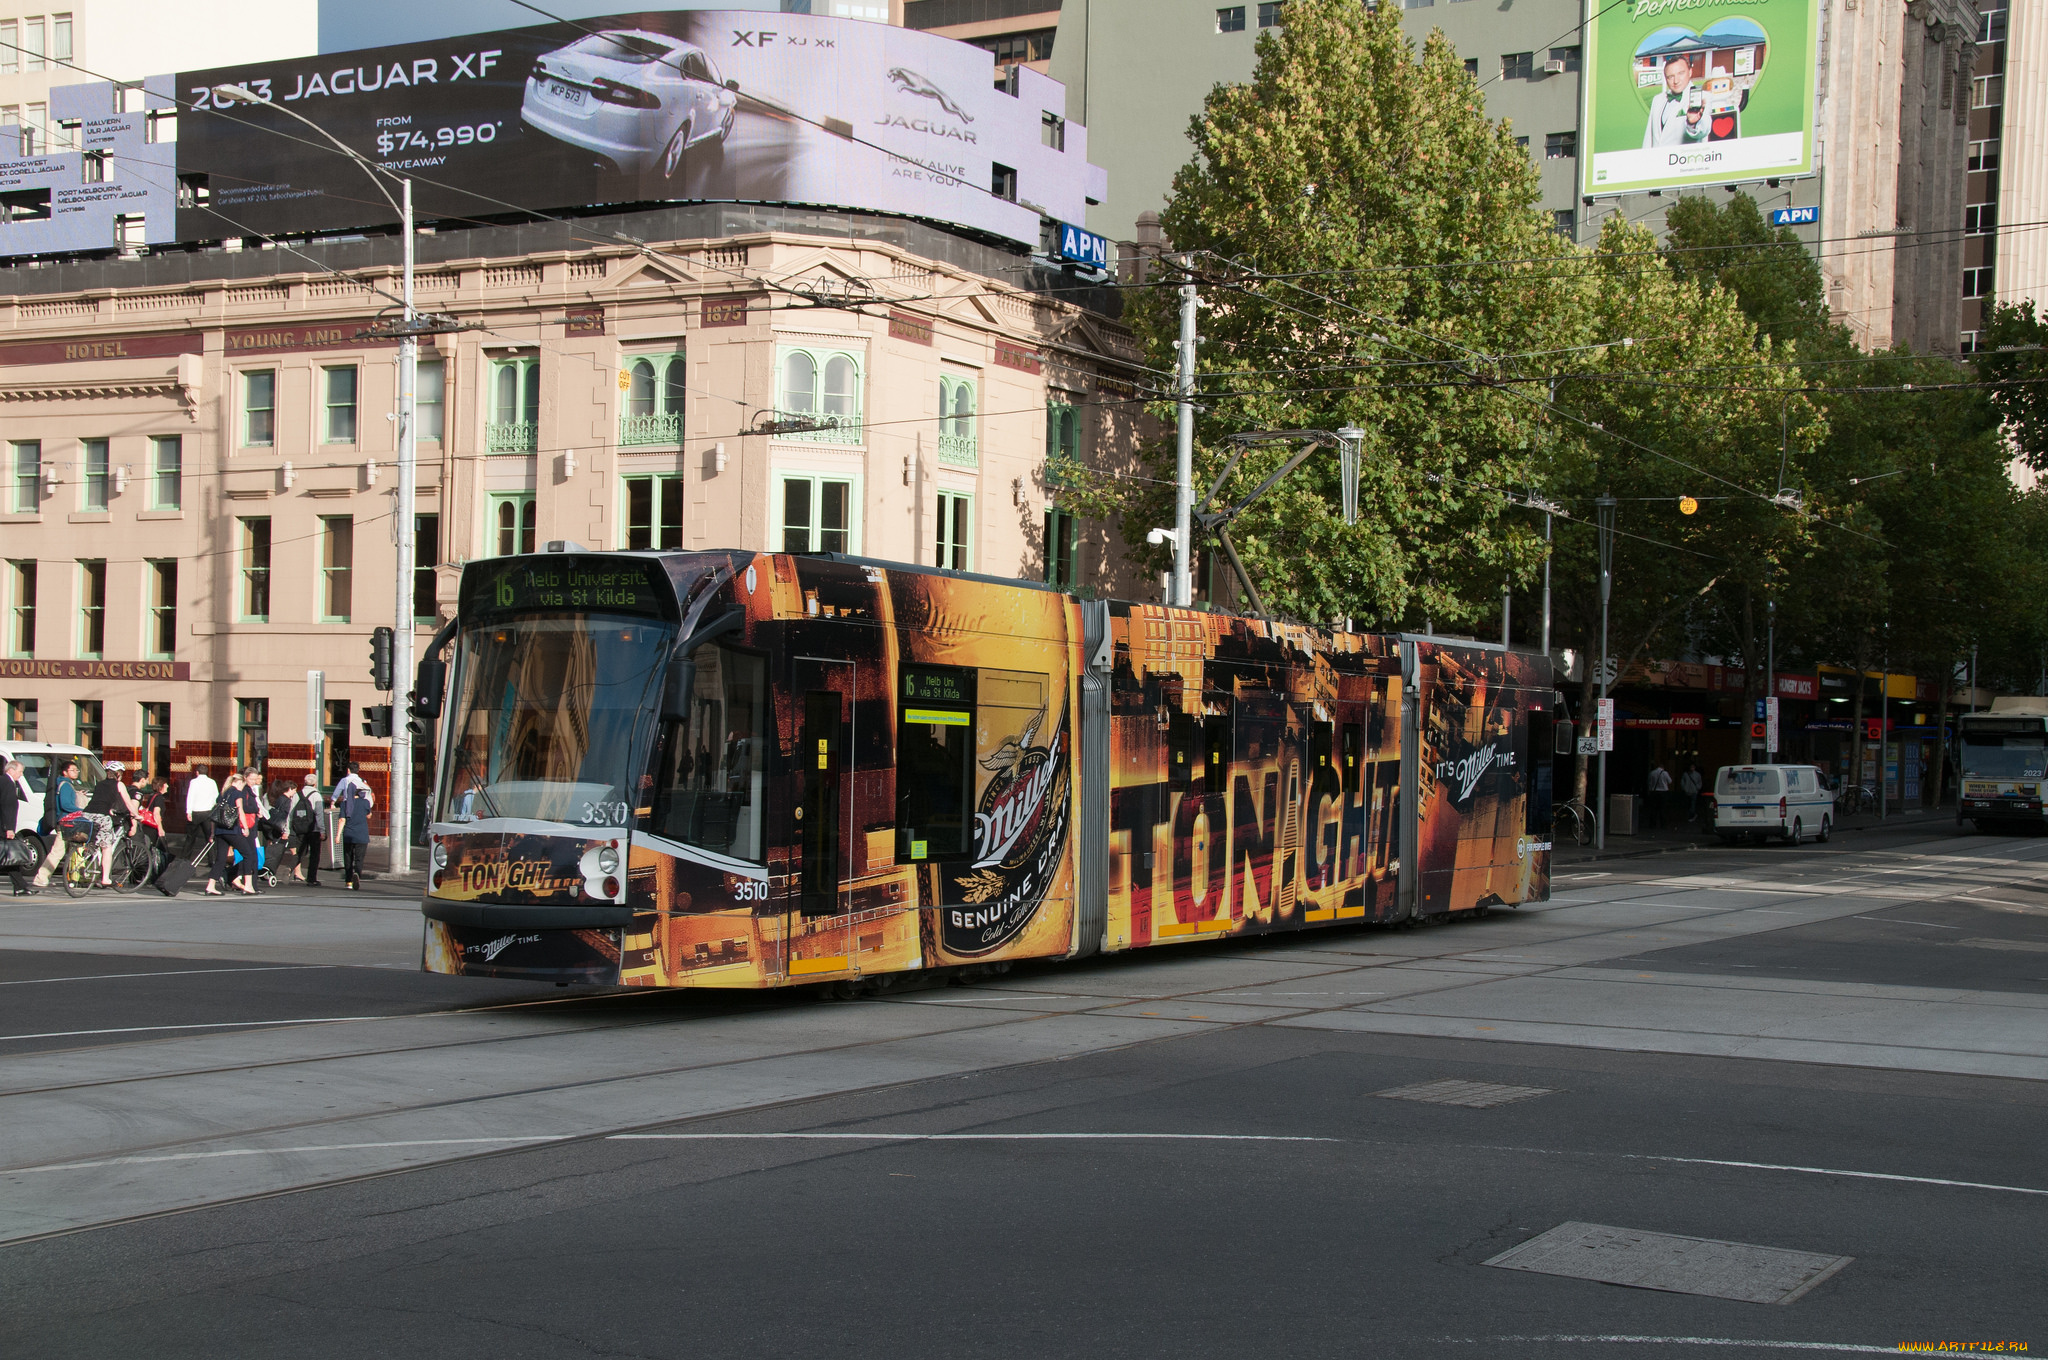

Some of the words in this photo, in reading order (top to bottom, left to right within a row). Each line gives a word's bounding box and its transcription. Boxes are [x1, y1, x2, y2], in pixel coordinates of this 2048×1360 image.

[731, 30, 777, 47] XF
[787, 36, 807, 46] XJ
[815, 39, 835, 48] XK
[284, 58, 438, 101] JAGUAR
[451, 50, 502, 82] XF
[1640, 73, 1662, 85] SOLD
[565, 88, 581, 102] 673
[87, 118, 121, 127] MALVERN
[103, 125, 131, 134] JAGUAR
[376, 116, 412, 127] FROM
[873, 114, 977, 145] JAGUAR
[376, 156, 447, 172] DRIVEAWAY
[888, 153, 924, 166] HOW
[927, 161, 966, 177] ALIVE
[1668, 150, 1723, 166] Domain
[38, 165, 65, 174] JAGUAR
[892, 168, 922, 180] ARE
[926, 173, 963, 189] YOU?
[58, 189, 77, 198] PORT
[79, 185, 122, 195] MELBOURNE
[58, 194, 102, 204] MELBOURNE
[103, 193, 119, 201] CITY
[120, 190, 148, 200] JAGUAR
[1779, 208, 1813, 223] APN
[1063, 228, 1105, 264] APN
[705, 305, 741, 323] 1875
[229, 332, 294, 350] YOUNG
[302, 328, 342, 347] AND
[892, 317, 930, 341] YOUNG
[1002, 346, 1031, 368] AND
[64, 340, 127, 360] HOTEL
[492, 572, 515, 607] 16
[524, 571, 560, 587] Melb
[540, 590, 563, 606] via
[570, 589, 588, 605] St
[597, 588, 636, 605] Kilda
[0, 661, 62, 678] YOUNG
[67, 666, 77, 676] &
[82, 661, 175, 679] JACKSON
[906, 674, 915, 696] 16
[925, 675, 941, 687] Melb
[943, 676, 955, 688] Uni
[920, 686, 931, 697] via
[933, 687, 941, 698] St
[943, 688, 960, 699] Kilda
[1436, 761, 1454, 779] IT'S
[1456, 742, 1497, 803] Miller
[974, 728, 1060, 869] Miller
[580, 801, 628, 825] 3510
[459, 860, 552, 892] TONIGHT
[734, 882, 769, 900] 3510
[951, 872, 1033, 929] GENUINE
[466, 945, 480, 954] IT'S
[480, 934, 517, 961] Miller
